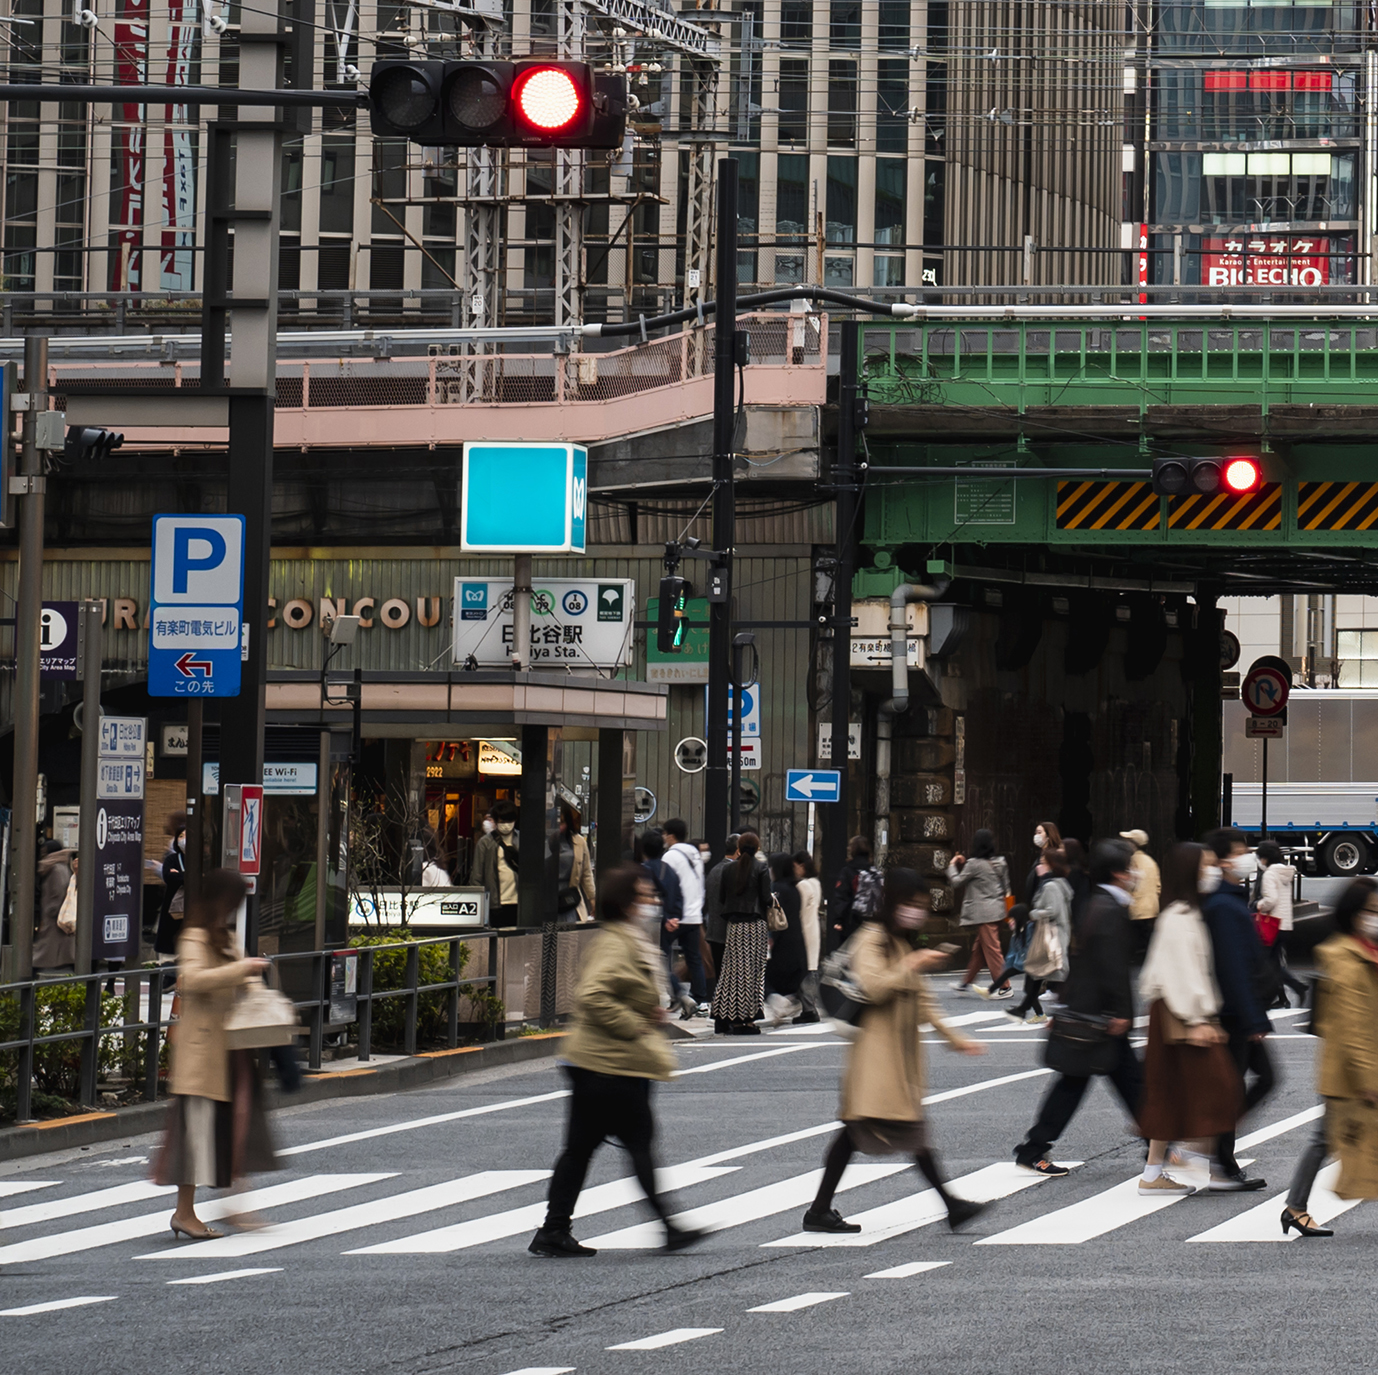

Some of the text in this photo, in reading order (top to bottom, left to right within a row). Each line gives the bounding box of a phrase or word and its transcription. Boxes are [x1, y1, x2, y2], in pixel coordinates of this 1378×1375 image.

[1224, 240, 1314, 258] カラオケ
[1208, 267, 1322, 286] BIG ECHO
[568, 601, 581, 610] 08
[155, 619, 237, 637] 有楽町電気ビル
[554, 645, 581, 658] Sta.
[174, 680, 215, 693] この先
[275, 767, 298, 776] Wi-Fi
[458, 904, 478, 915] A2
